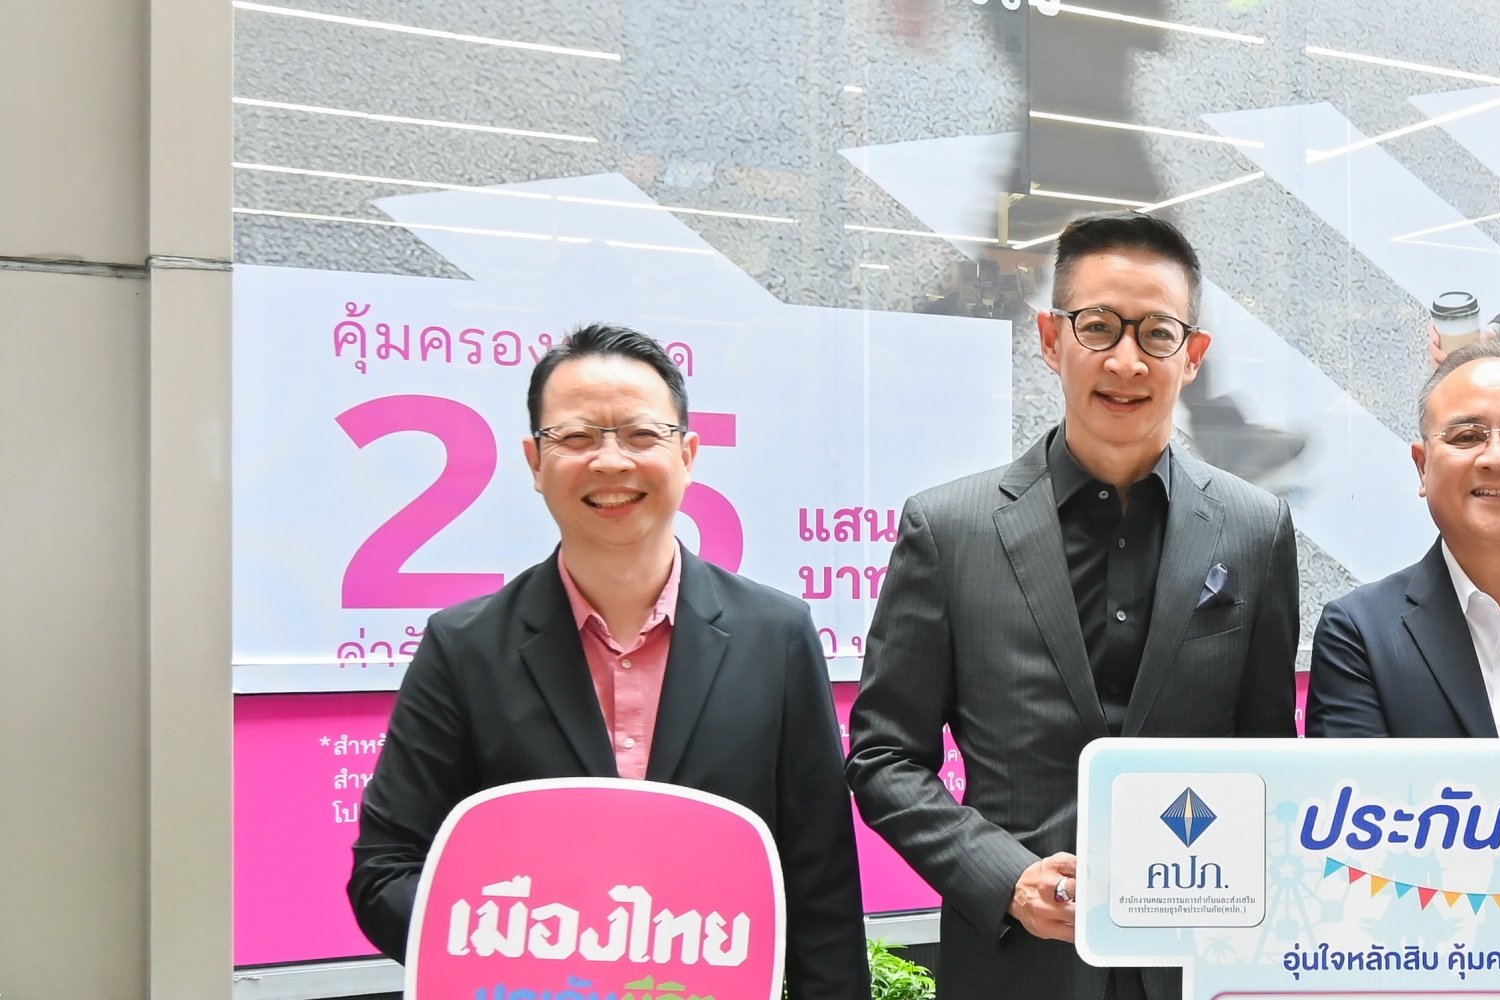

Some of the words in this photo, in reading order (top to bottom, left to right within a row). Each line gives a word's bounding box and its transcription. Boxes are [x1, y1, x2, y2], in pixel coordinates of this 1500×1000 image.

[799, 507, 897, 542] แสน
[1146, 855, 1229, 889] คปภ.
[446, 874, 750, 968] เมืองไทย
[1283, 942, 1439, 981] อุ่นใจหลักสิบ
